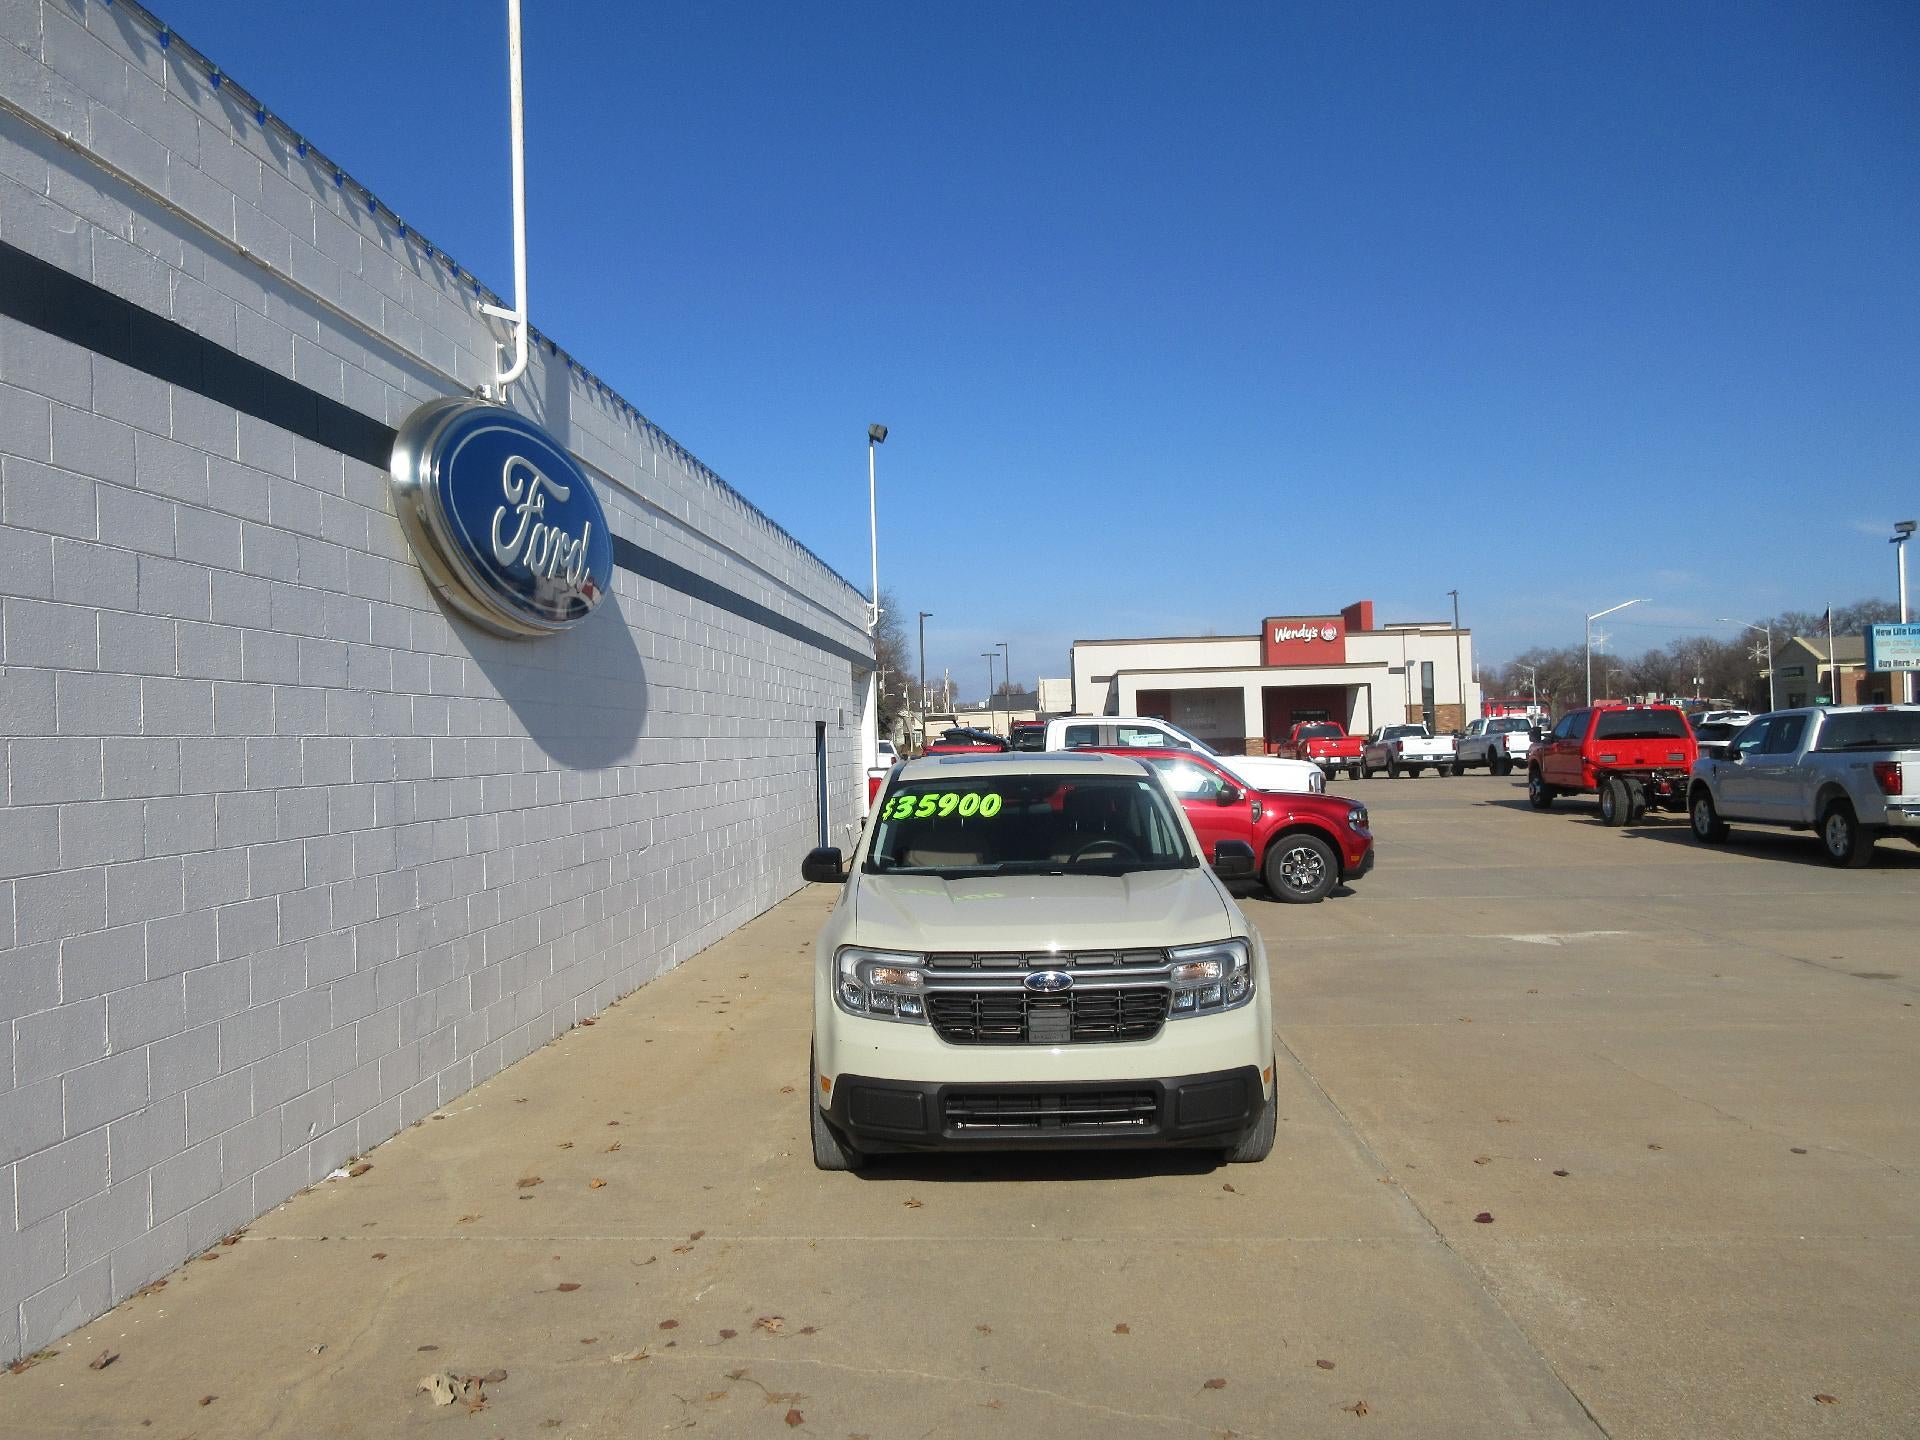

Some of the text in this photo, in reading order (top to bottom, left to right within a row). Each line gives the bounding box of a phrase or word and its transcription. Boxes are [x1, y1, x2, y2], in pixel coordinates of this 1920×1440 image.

[491, 454, 592, 588] Ford
[1274, 623, 1319, 643] Wendy's
[882, 793, 1002, 821] $35900
